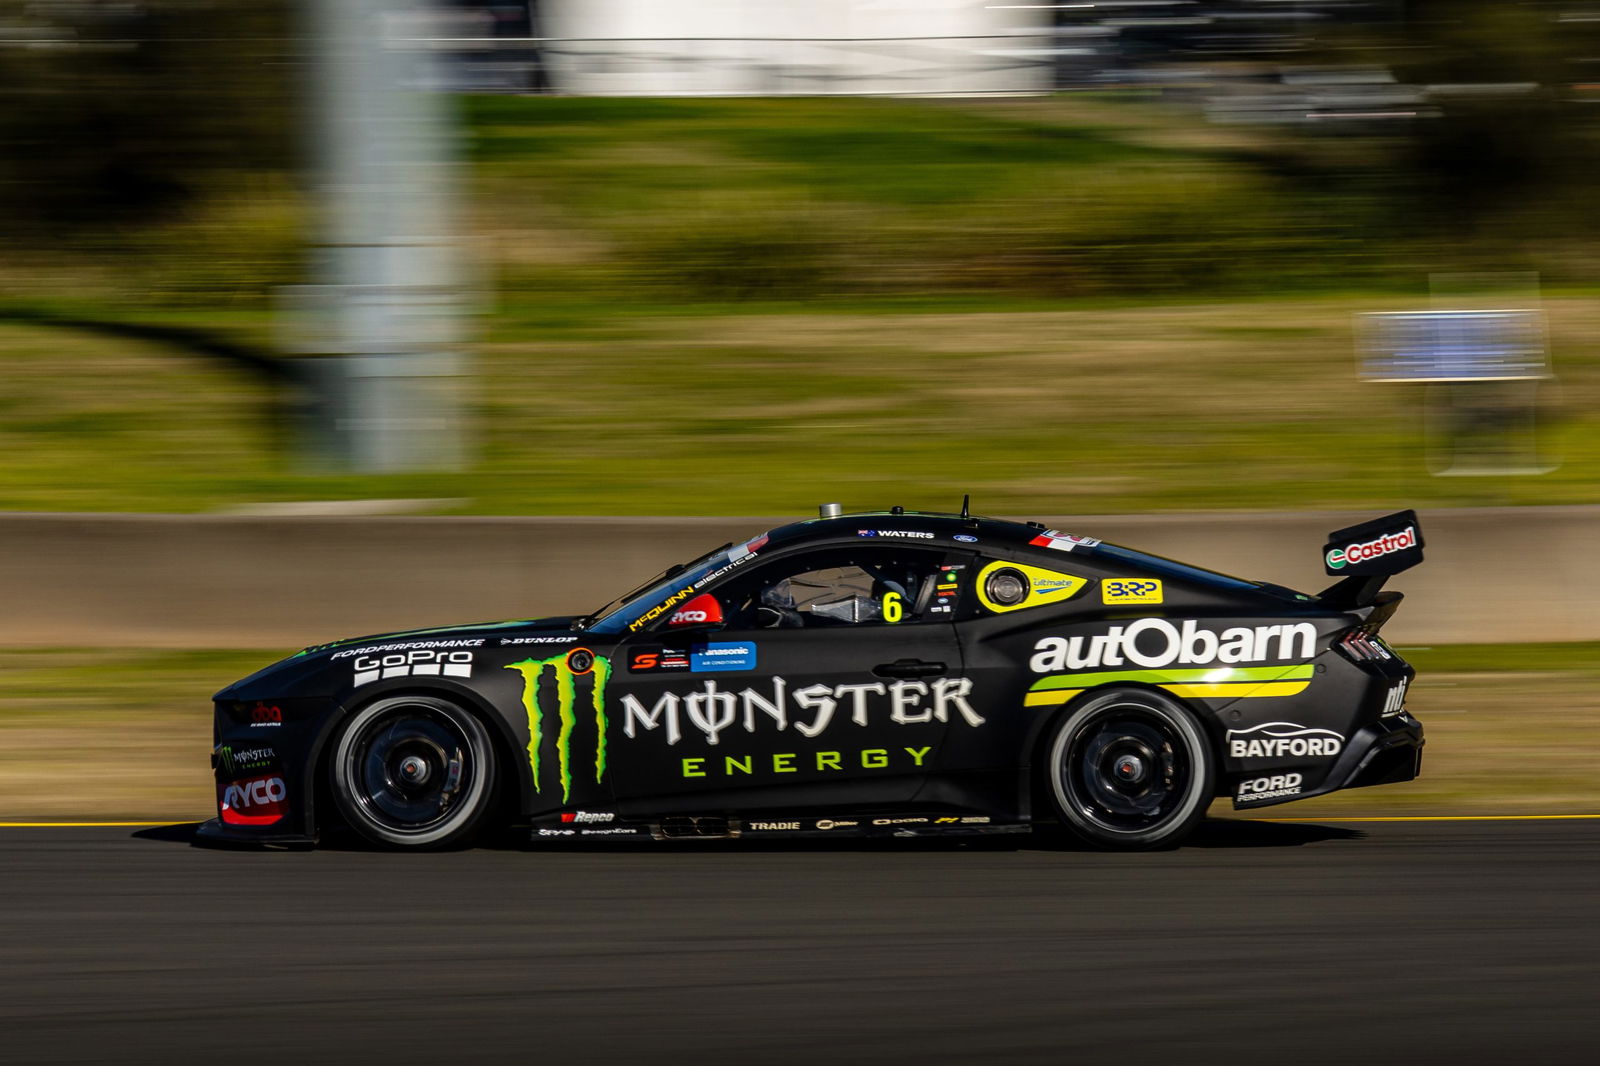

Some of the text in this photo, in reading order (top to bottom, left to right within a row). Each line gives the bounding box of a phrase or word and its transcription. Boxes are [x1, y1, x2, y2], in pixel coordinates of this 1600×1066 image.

[878, 530, 935, 539] WATERS
[1345, 527, 1416, 564] Castrol
[694, 551, 758, 589] electrical
[1033, 579, 1073, 587] ultimate
[1107, 581, 1157, 597] BRP
[882, 591, 903, 623] 6
[671, 610, 707, 623] RYCO
[511, 636, 578, 644] DUNLOP
[354, 650, 474, 672] GoPro
[619, 676, 986, 746] MONSTER
[234, 747, 275, 763] MONSTER
[1231, 738, 1341, 757] BAYFORD
[682, 746, 932, 778] ENERGY
[1238, 773, 1303, 795] FORD
[222, 777, 287, 810] RYCO
[1237, 787, 1302, 802] PERFORMANCE
[574, 811, 615, 824] Repco
[750, 821, 801, 830] TRADIE
